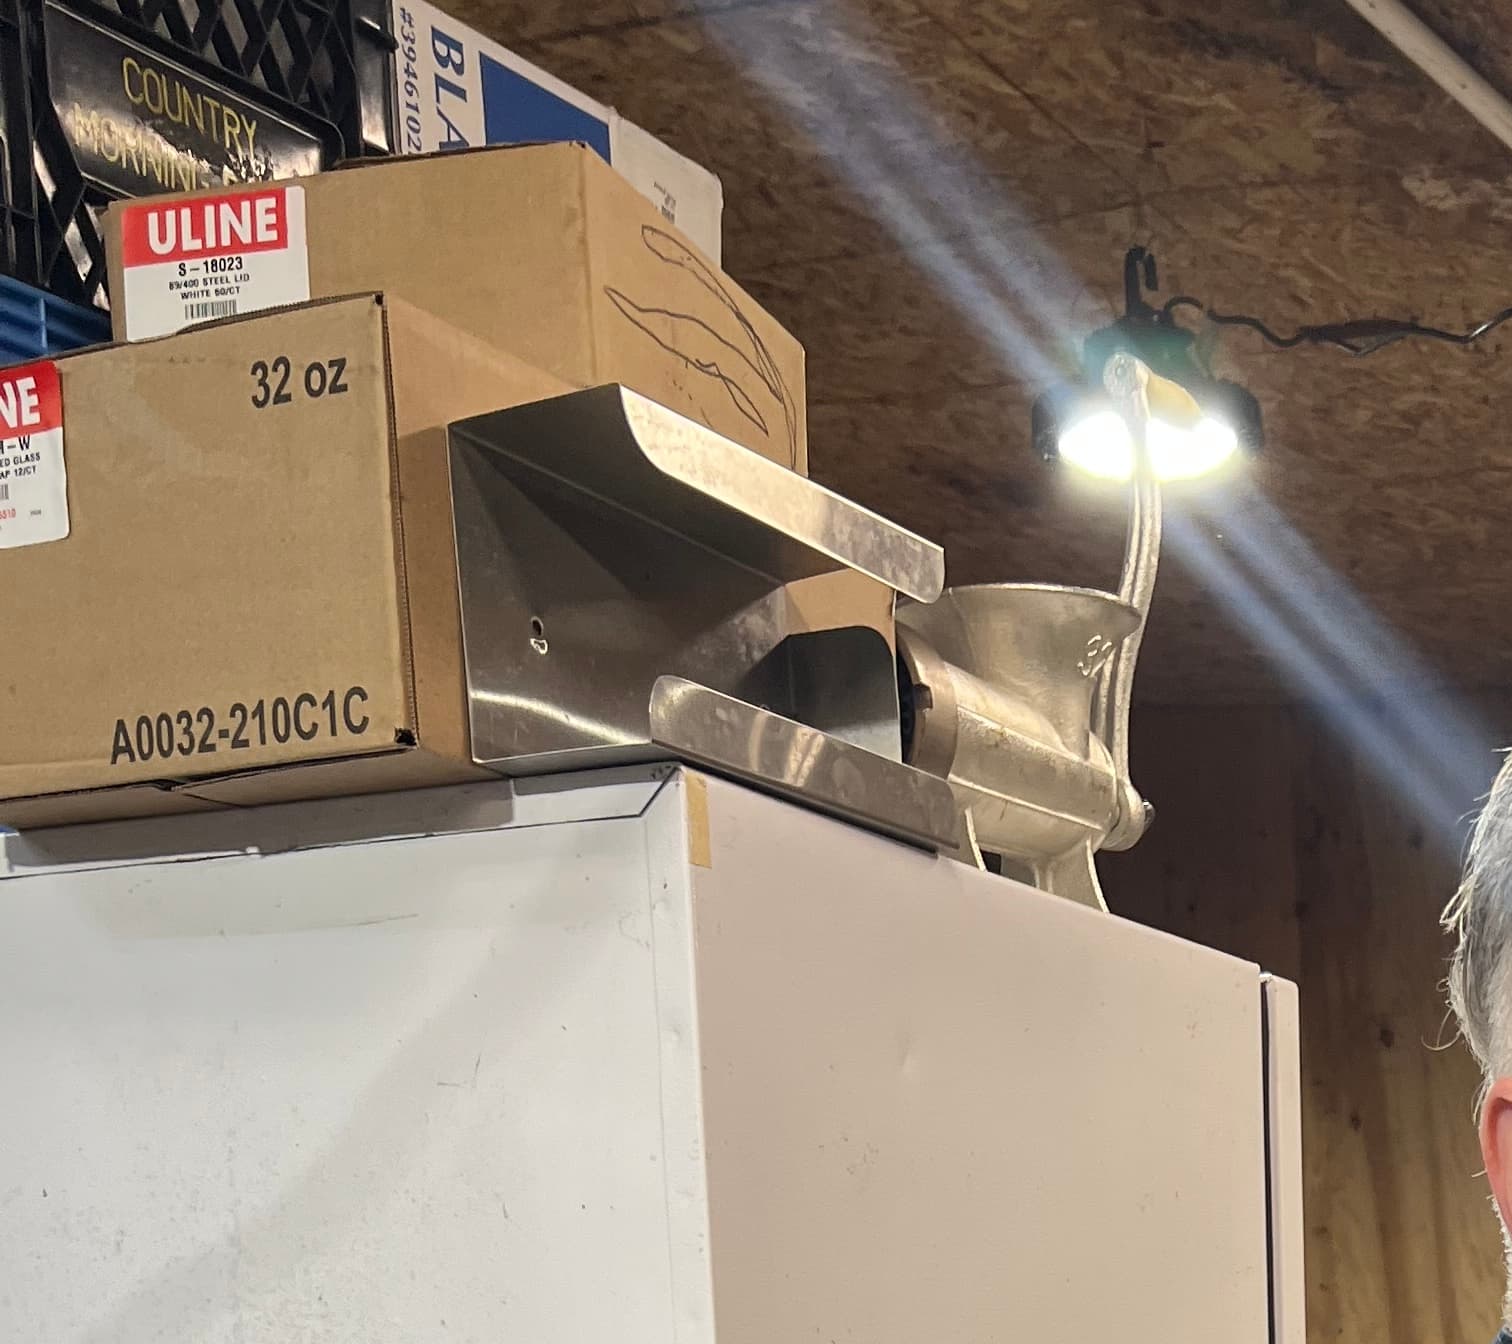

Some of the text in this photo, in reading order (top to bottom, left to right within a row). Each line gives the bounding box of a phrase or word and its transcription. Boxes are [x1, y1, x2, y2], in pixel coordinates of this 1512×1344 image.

[122, 57, 257, 161] COUNTRY
[400, 7, 422, 155] #3946102
[73, 102, 209, 193] MORNIN
[147, 197, 279, 255] ULINE
[180, 288, 211, 300] WHITE
[202, 275, 231, 287] STEEL
[234, 273, 250, 283] LID
[250, 355, 348, 409] 32 oz
[13, 451, 41, 466] GLASS
[110, 685, 370, 765] A0032-210C1C
